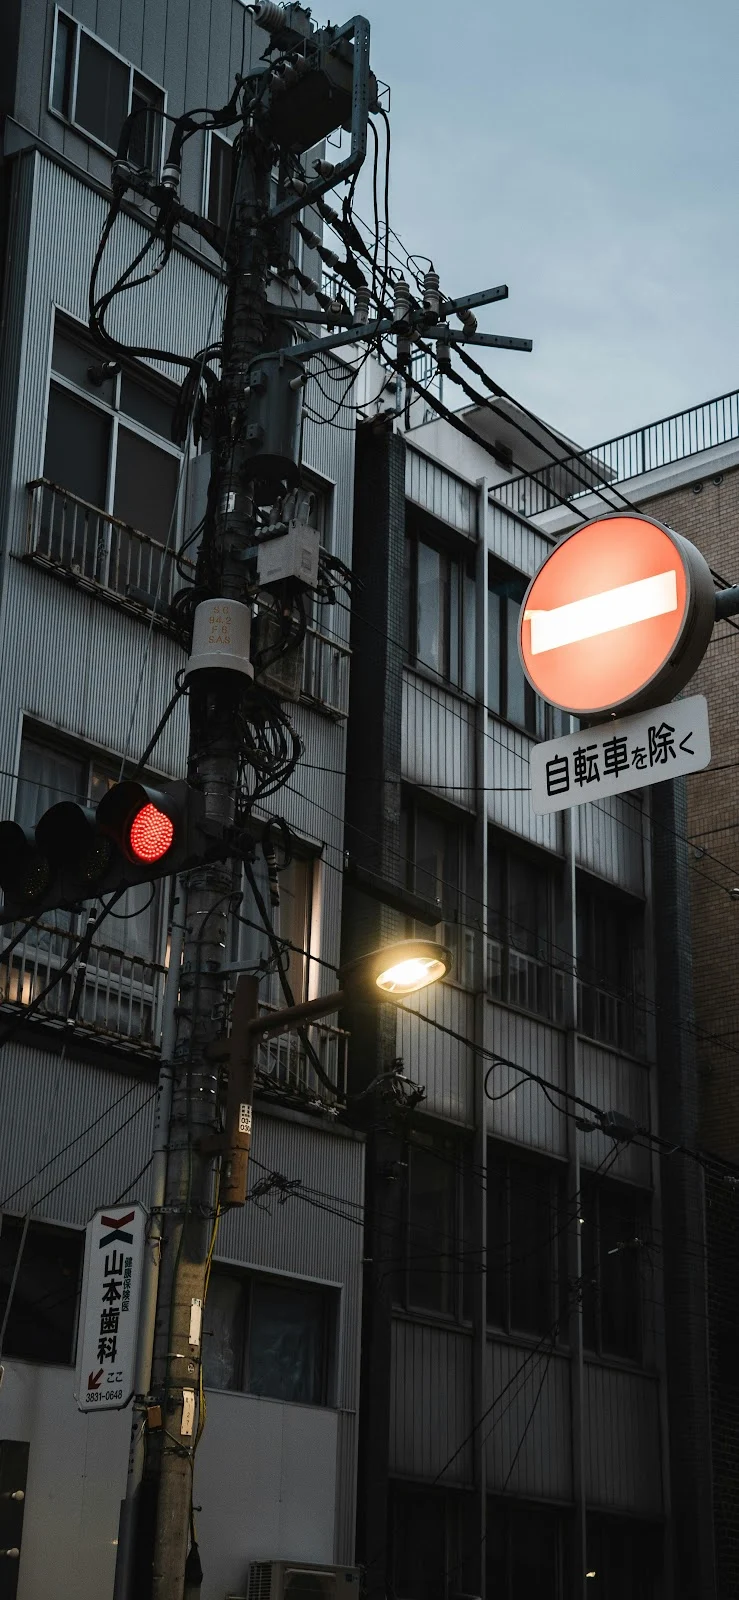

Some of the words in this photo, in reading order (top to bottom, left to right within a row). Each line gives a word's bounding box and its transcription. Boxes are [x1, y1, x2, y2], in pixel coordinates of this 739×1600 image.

[545, 722, 695, 797] 自転車を除く
[97, 1250, 124, 1364] 山本歯科
[121, 1256, 133, 1312] 健康保険医
[85, 1389, 123, 1402] 3831-0648
[107, 1371, 123, 1383] ここ
